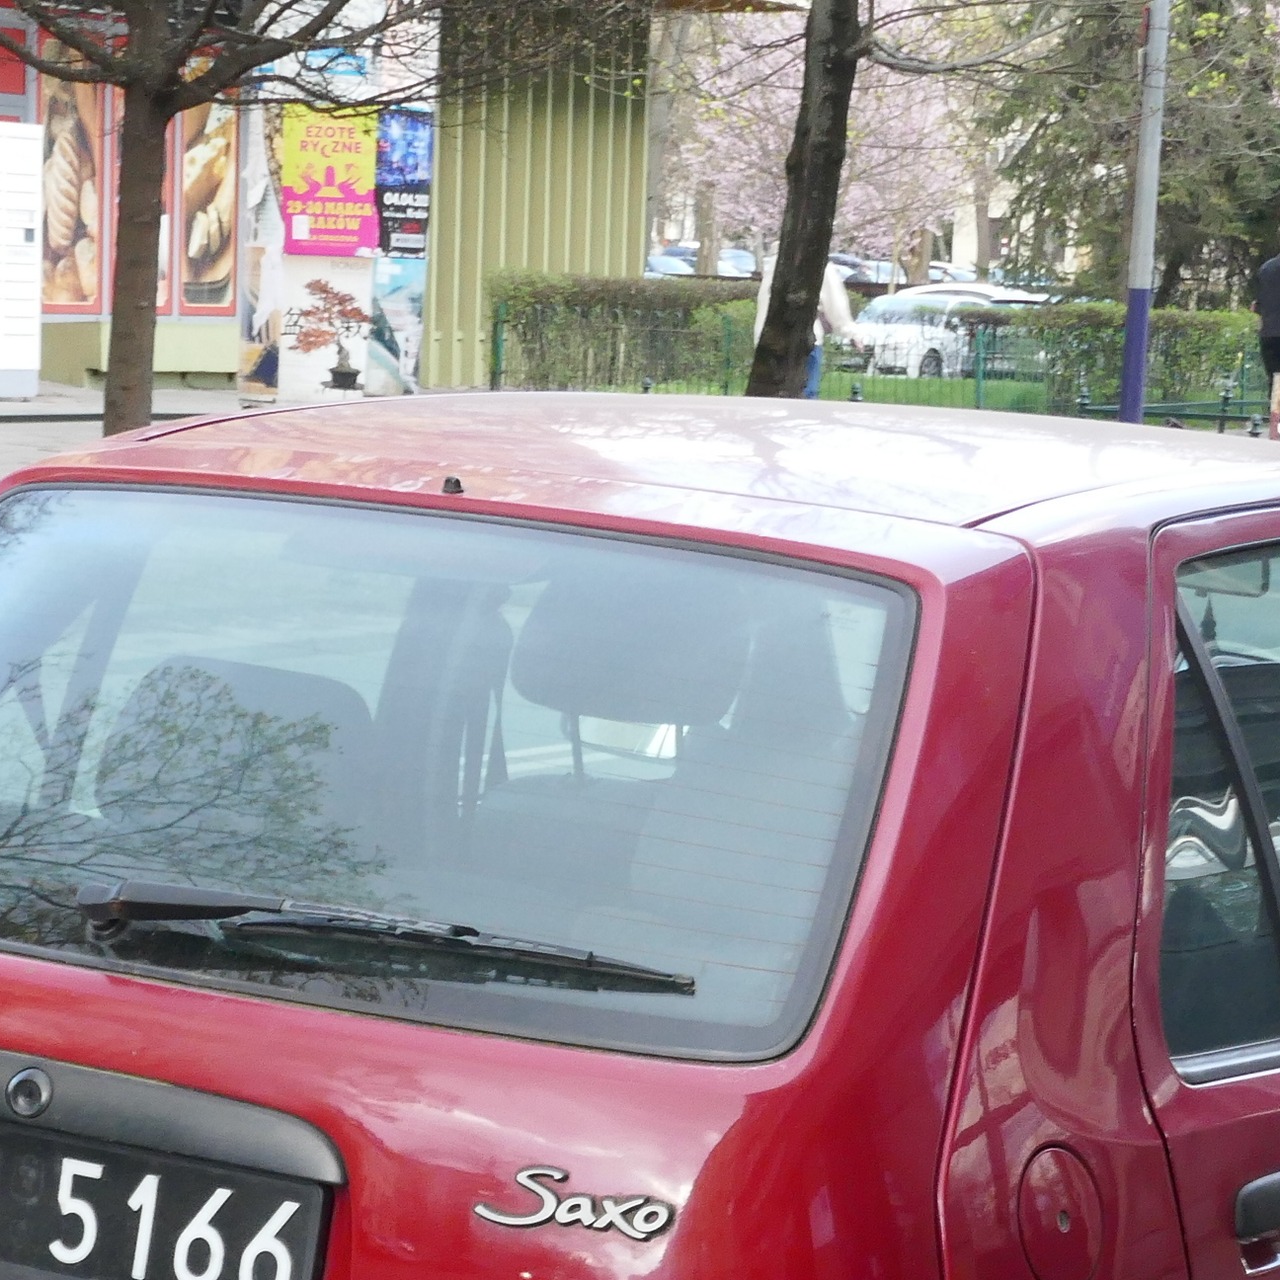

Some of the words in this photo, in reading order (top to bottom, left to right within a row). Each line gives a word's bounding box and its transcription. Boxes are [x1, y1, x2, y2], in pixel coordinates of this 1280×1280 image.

[306, 126, 356, 139] EZOTE
[309, 214, 361, 230] RAKÓW
[474, 1165, 674, 1241] Saxo
